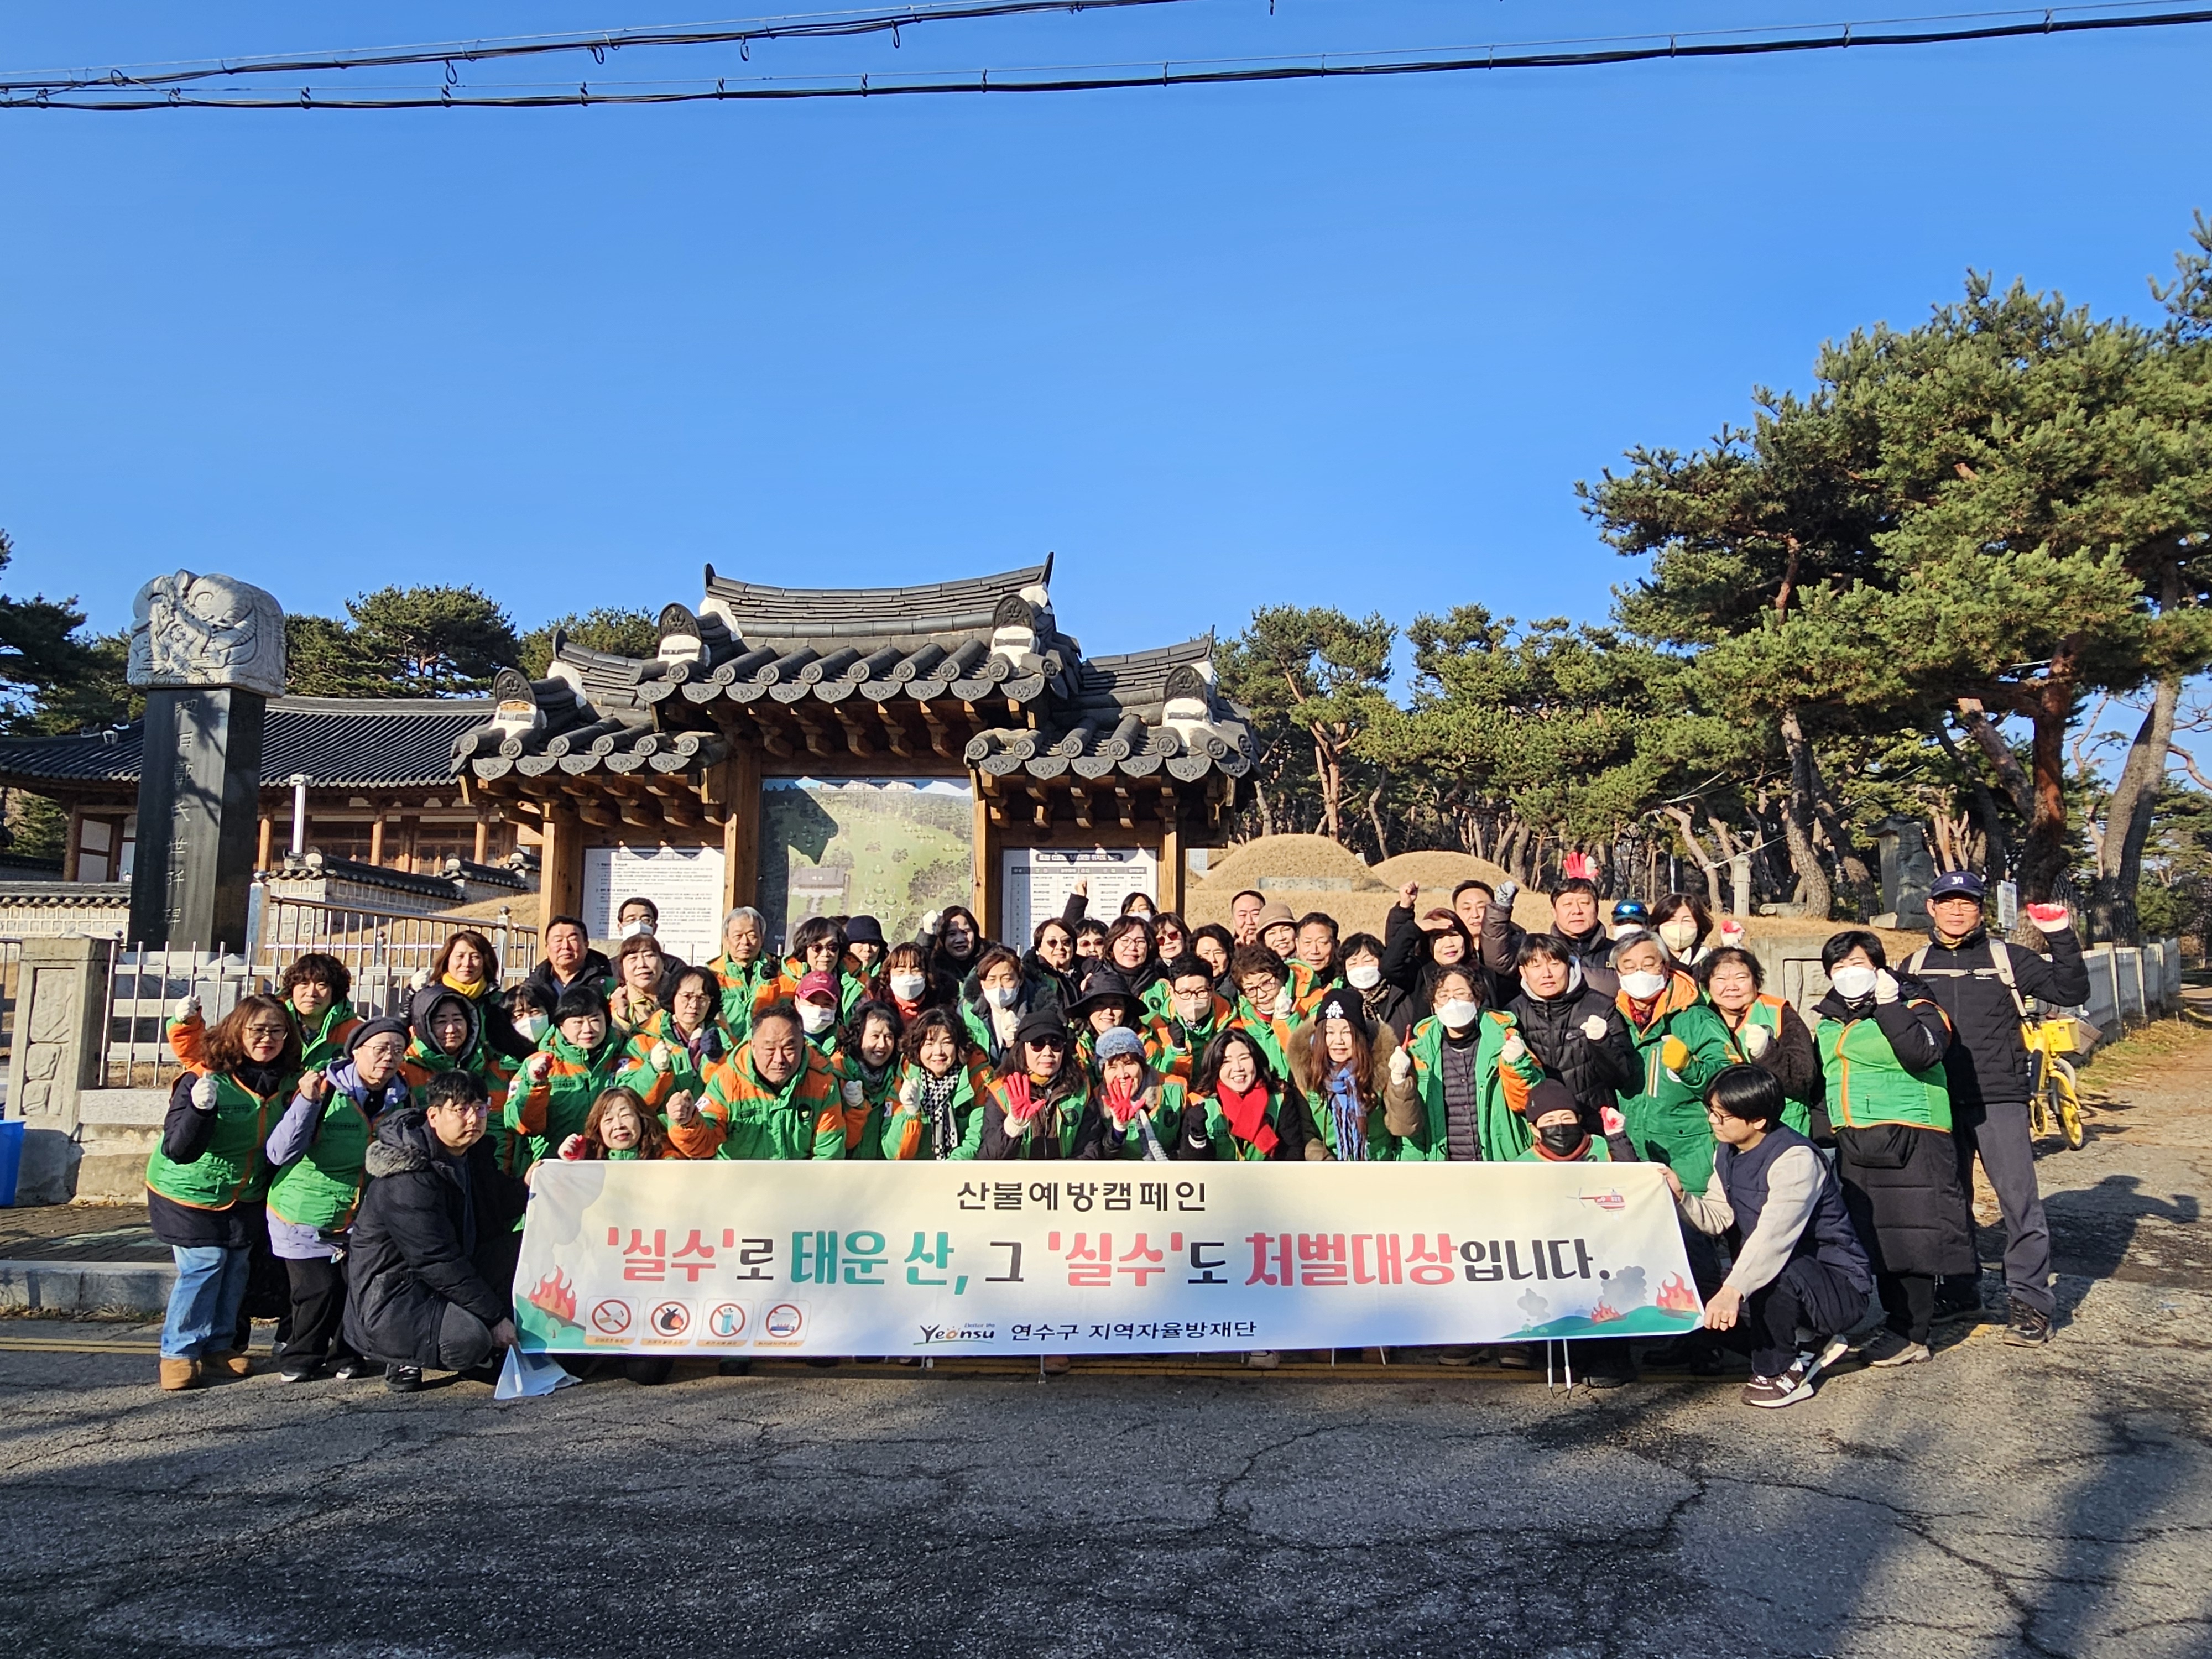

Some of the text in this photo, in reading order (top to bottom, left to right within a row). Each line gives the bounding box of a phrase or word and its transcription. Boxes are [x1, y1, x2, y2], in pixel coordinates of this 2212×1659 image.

[957, 1181, 1206, 1212] 산불예방캠페인
[608, 1227, 1610, 1295] '실수'로 태운 산, 그 '실수'도 처벌대상입니다.
[919, 1323, 995, 1344] Yeonsu
[1011, 1321, 1257, 1342] 연수구 지역자율방재단
